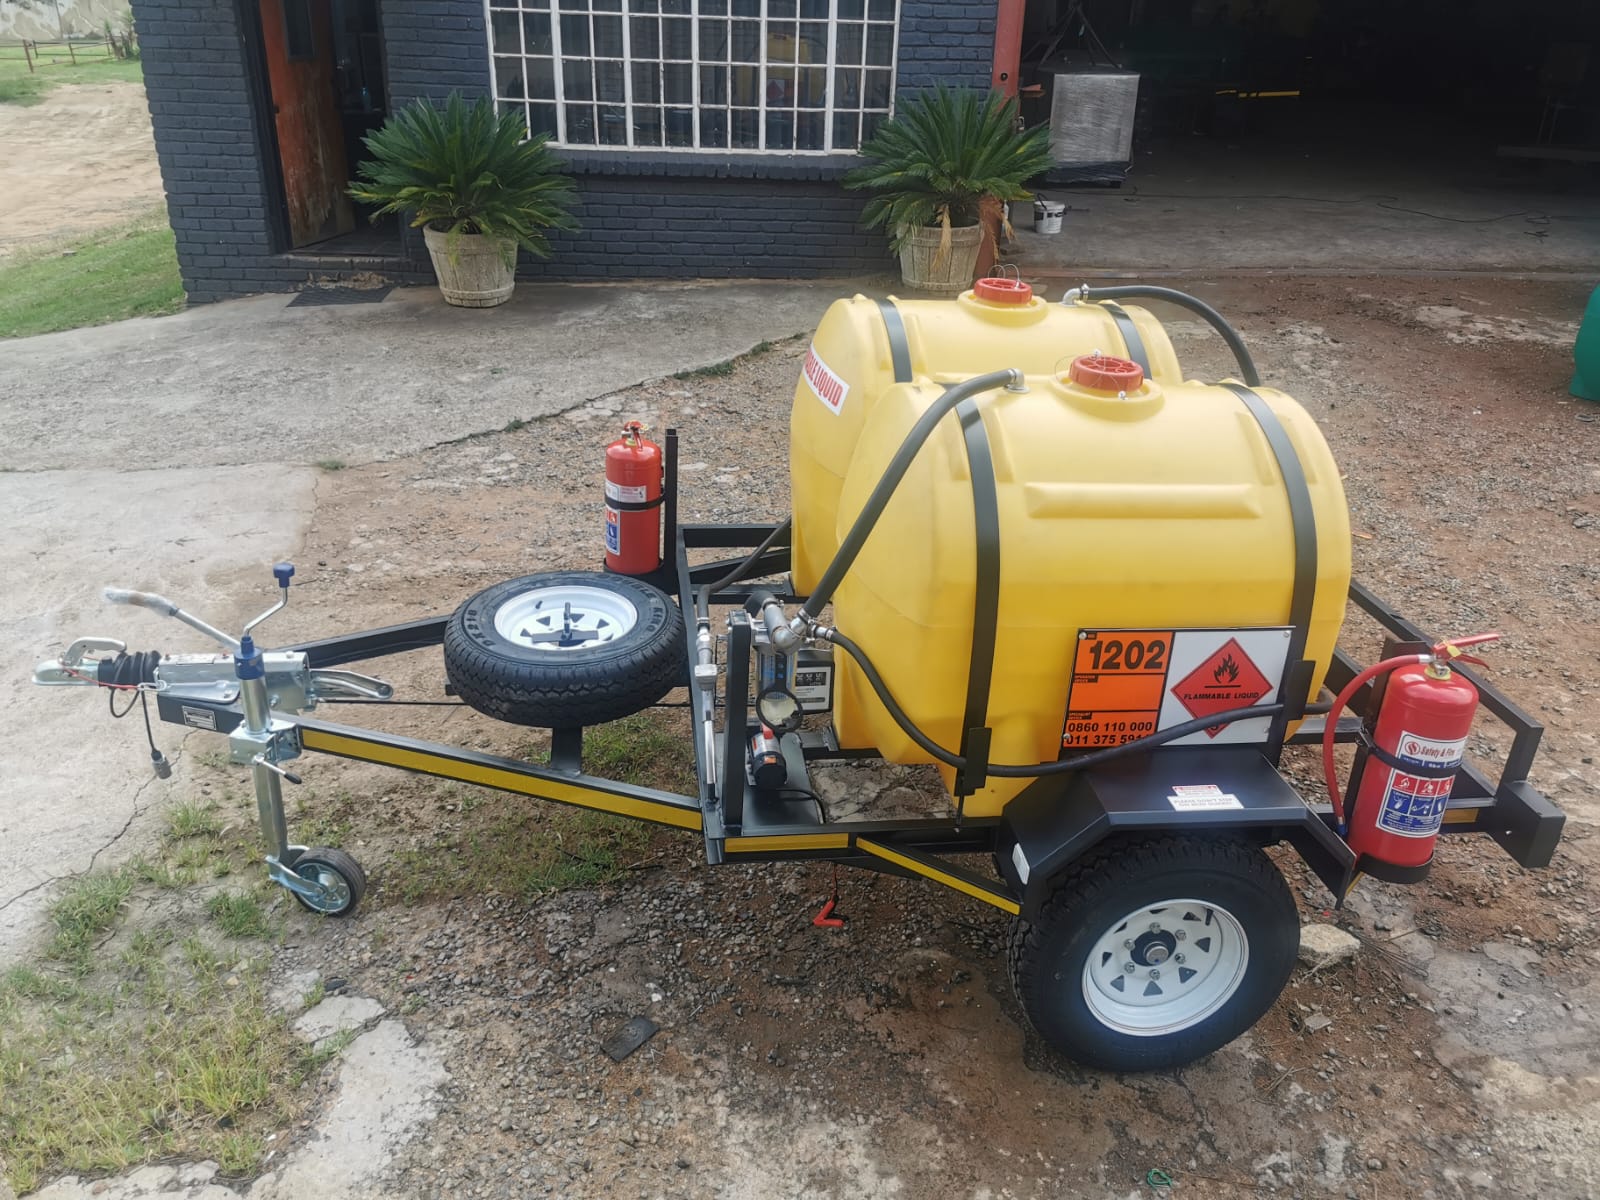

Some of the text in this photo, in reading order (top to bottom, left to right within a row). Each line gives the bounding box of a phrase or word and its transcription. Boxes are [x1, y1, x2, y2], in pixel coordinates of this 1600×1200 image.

[1090, 640, 1165, 669] 1202
[1183, 692, 1231, 700] FLAMMABLE
[1068, 721, 1152, 732] 0860 110 000
[1066, 735, 1089, 745] 011
[1093, 734, 1116, 744] 375
